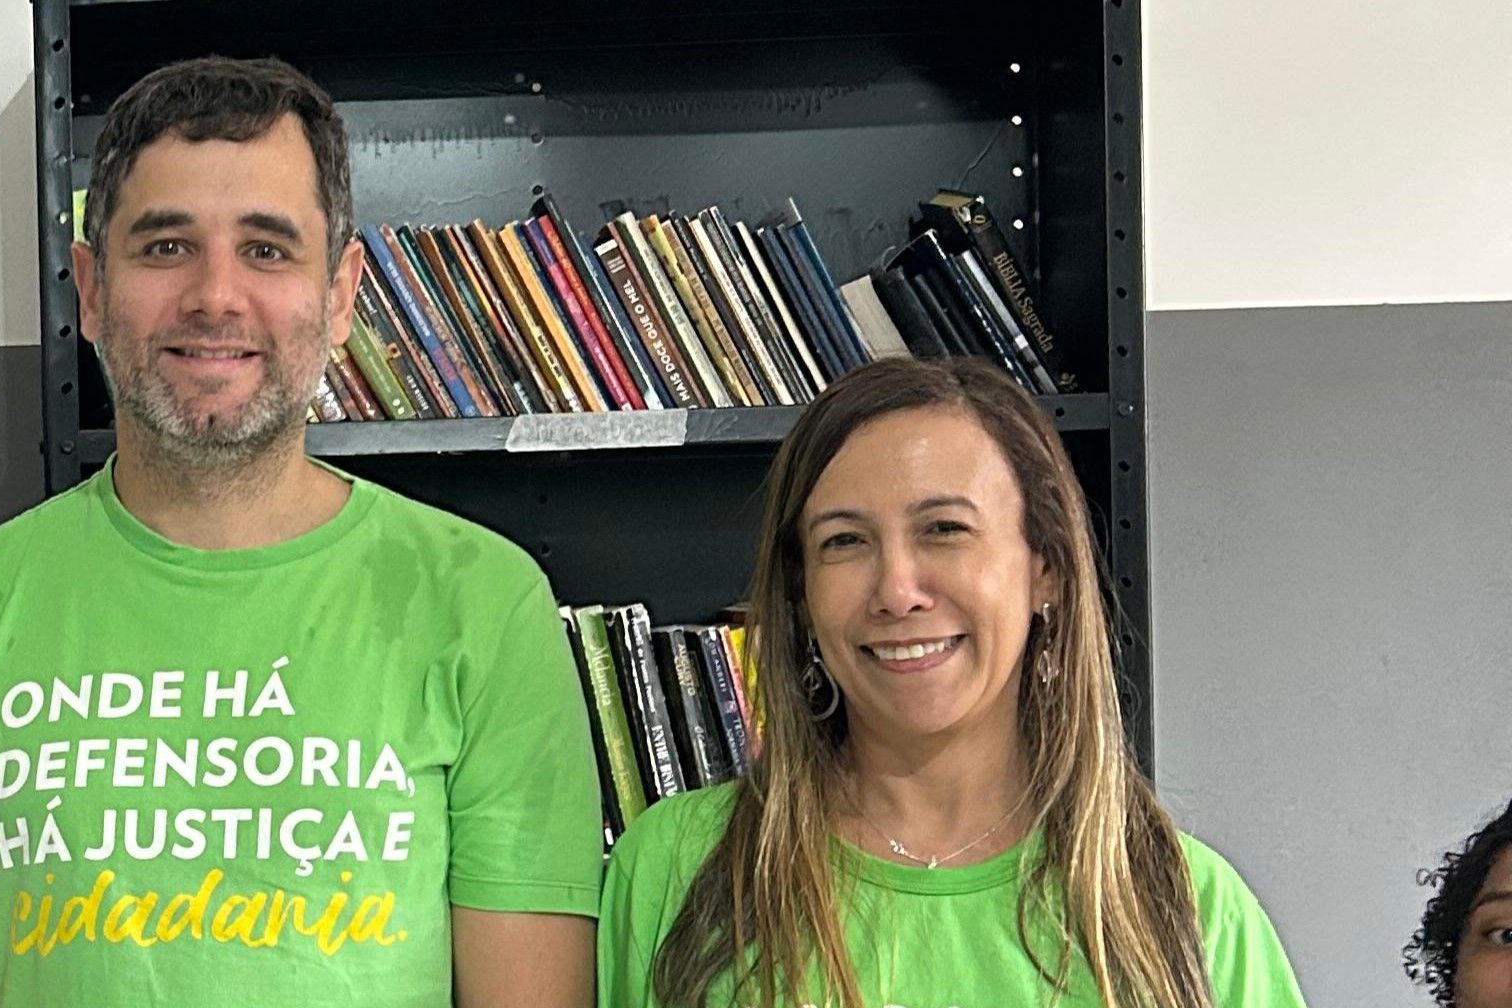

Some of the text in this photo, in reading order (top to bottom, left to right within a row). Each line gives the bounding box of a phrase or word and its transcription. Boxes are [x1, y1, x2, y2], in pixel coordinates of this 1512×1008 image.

[622, 279, 690, 401] MAIS DOCE QUE O MEL
[1019, 296, 1054, 353] Sagrada
[1, 656, 296, 728] ONDE HÁ
[677, 643, 696, 696] AUGUSTO
[84, 808, 369, 877] JUSTIÇA
[381, 811, 416, 861] E
[10, 868, 408, 956] cidadania.
